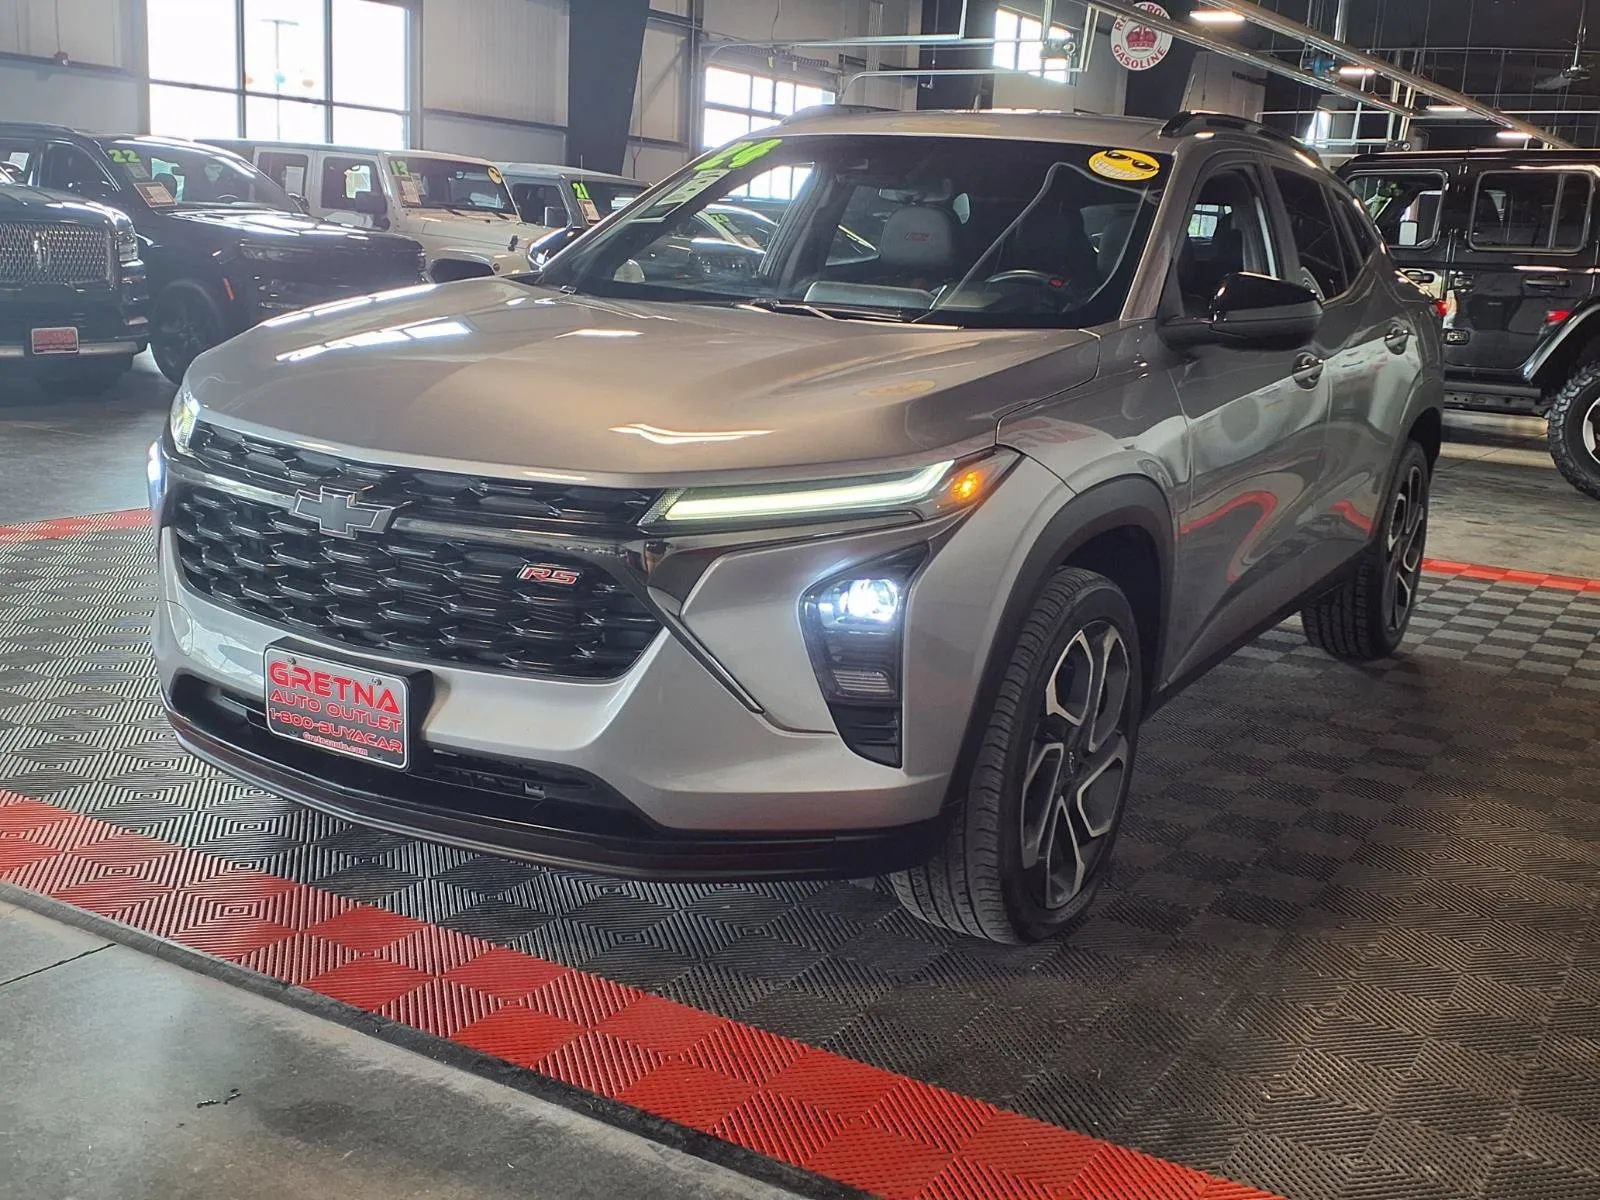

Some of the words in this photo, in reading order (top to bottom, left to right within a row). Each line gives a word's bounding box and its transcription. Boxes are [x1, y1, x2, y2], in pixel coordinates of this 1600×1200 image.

[1113, 44, 1166, 69] GASOLINE
[107, 149, 141, 163] 22
[572, 182, 590, 199] 21
[519, 565, 580, 585] RS
[269, 659, 401, 715] GRETNA
[270, 689, 321, 713] AUTO
[326, 703, 403, 733] OUTLET
[270, 708, 403, 753] 1-800-BUYACAR
